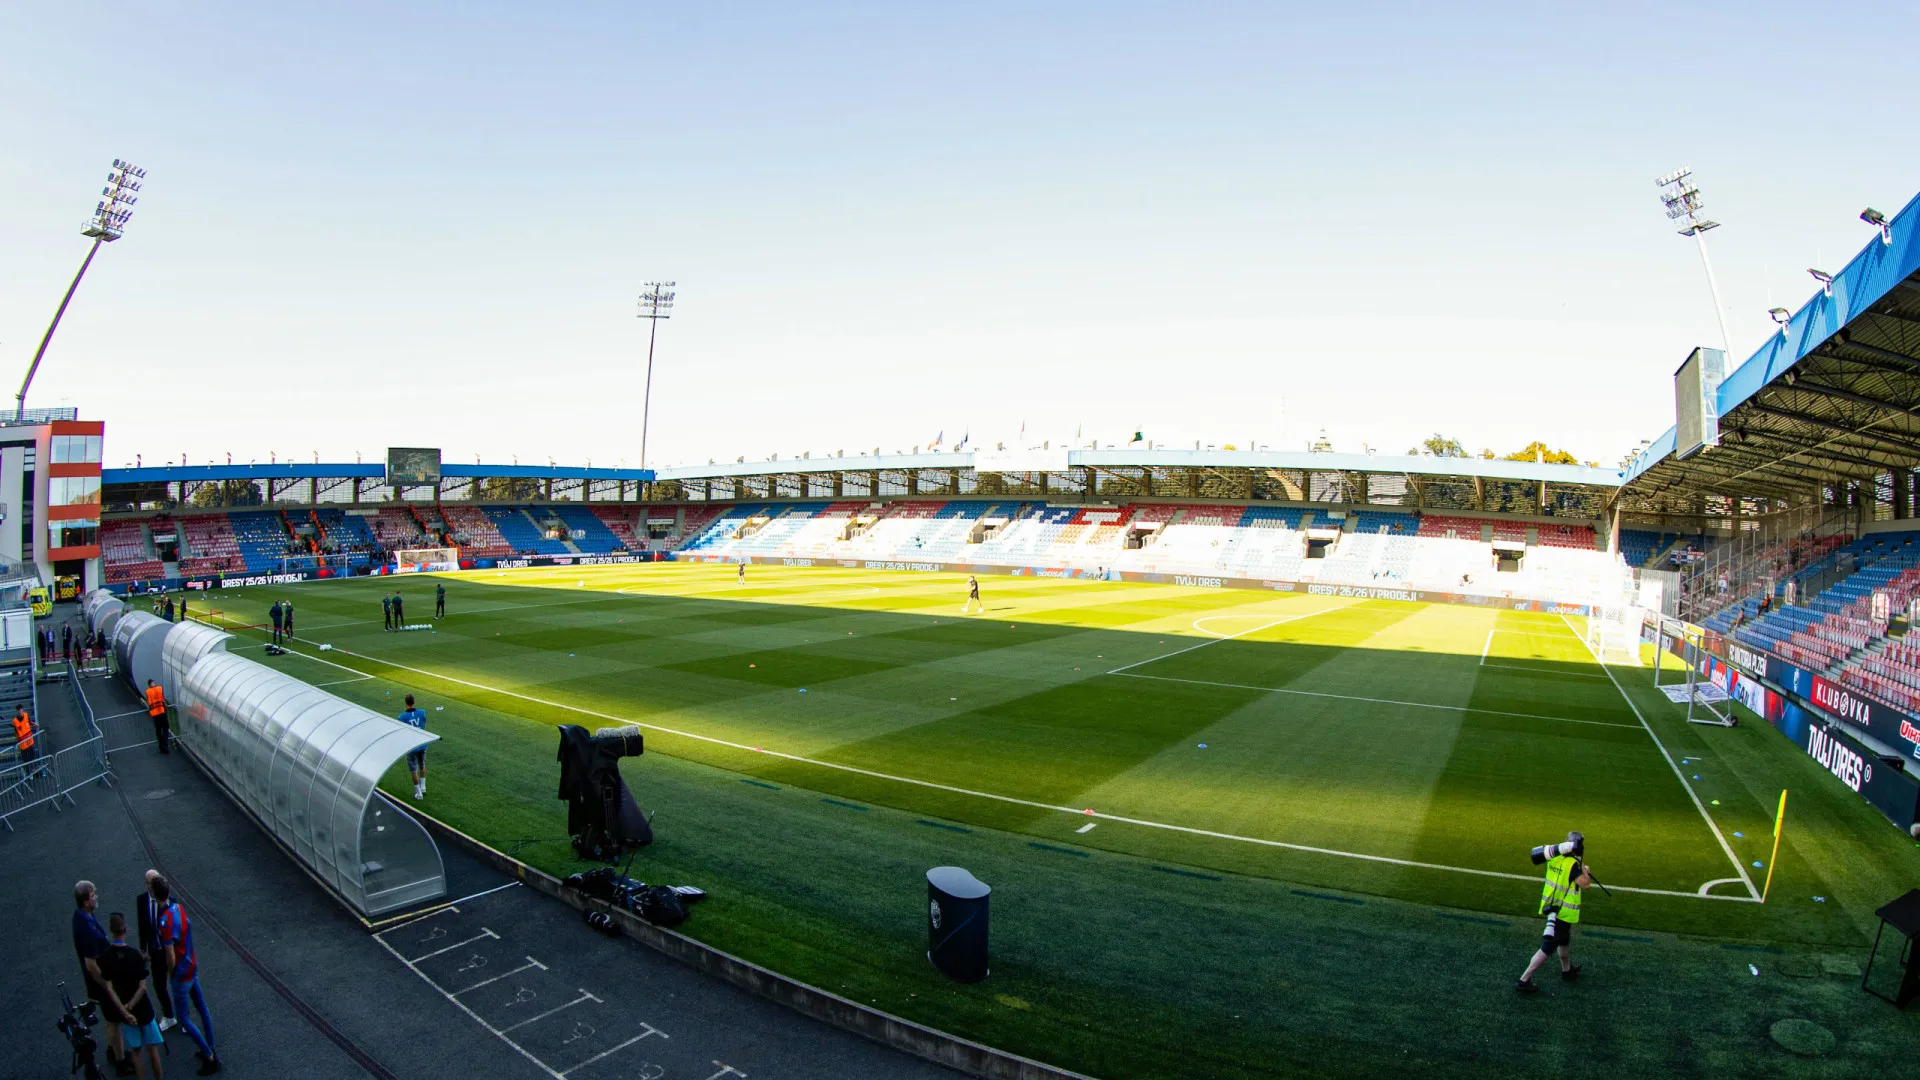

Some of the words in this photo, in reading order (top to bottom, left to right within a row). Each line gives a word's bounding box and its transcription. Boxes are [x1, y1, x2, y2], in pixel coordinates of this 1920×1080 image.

[221, 578, 245, 588] DRESY
[245, 576, 267, 586] 25/26
[267, 575, 273, 584] V
[1198, 577, 1221, 587] DRES
[1308, 584, 1338, 595] DRESY
[1339, 587, 1367, 598] 25/26
[1368, 589, 1376, 599] V
[1376, 589, 1417, 602] PRODEJI
[1807, 724, 1834, 769] TVŮJ
[1831, 741, 1864, 792] DRES
